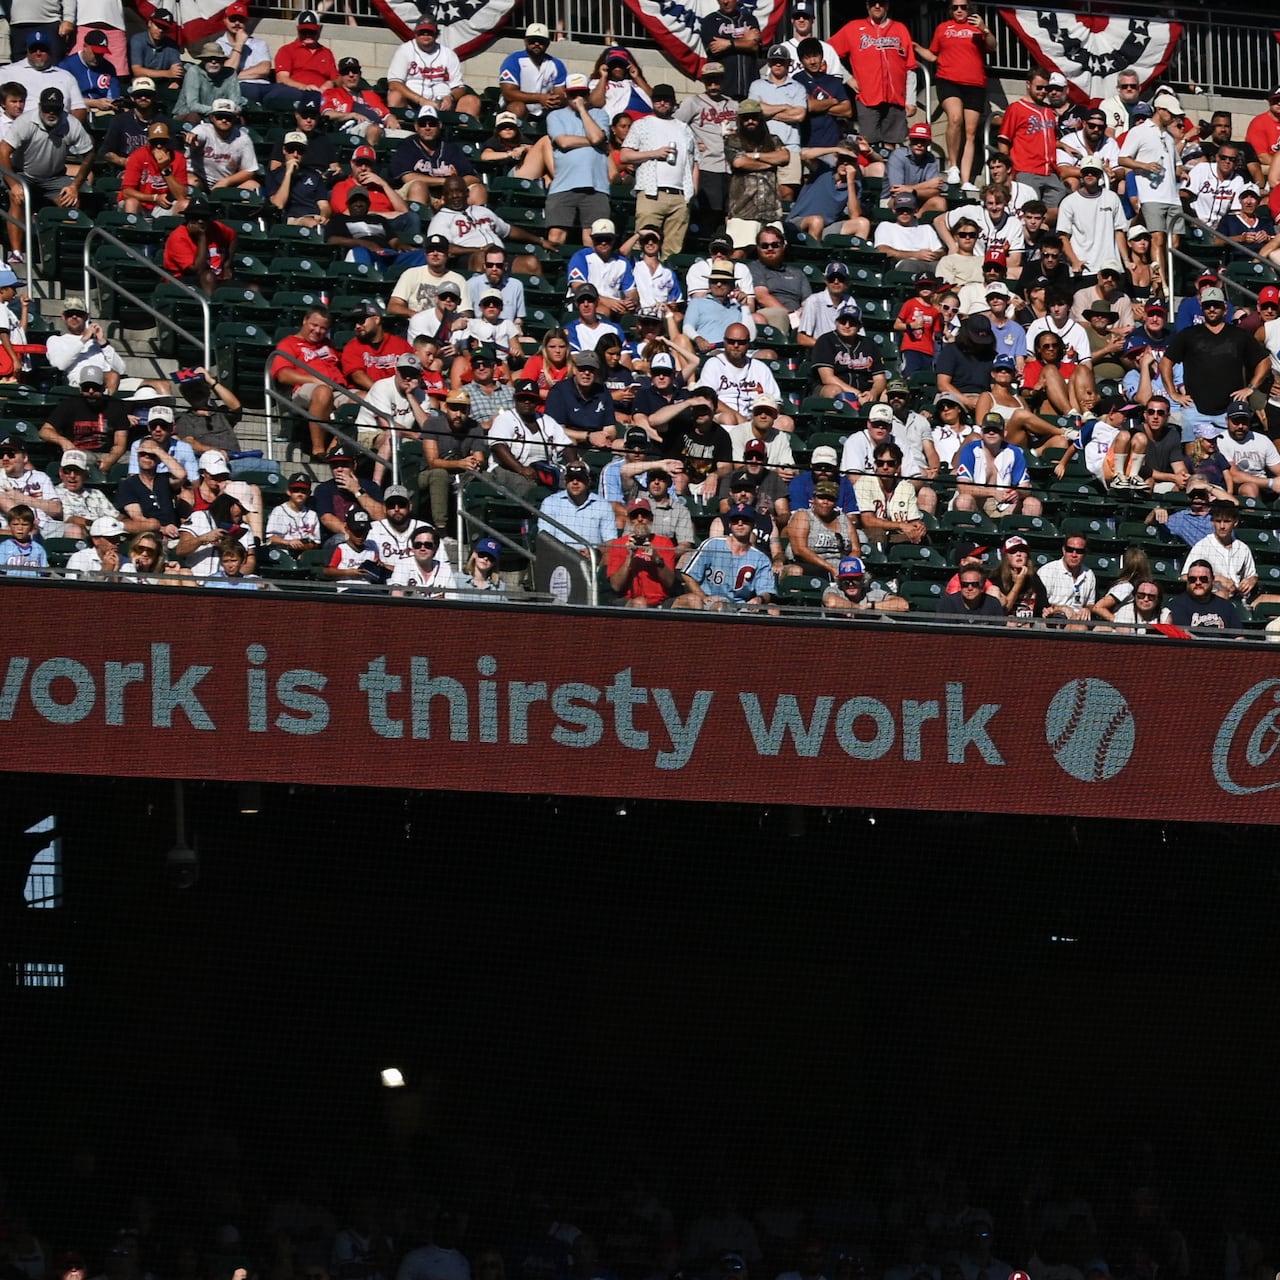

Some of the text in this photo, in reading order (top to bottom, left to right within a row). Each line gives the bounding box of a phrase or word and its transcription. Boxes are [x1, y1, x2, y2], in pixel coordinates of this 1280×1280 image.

[860, 34, 902, 50] Braves
[1200, 181, 1232, 197] Braves
[719, 375, 758, 393] Braves
[735, 566, 755, 589] P
[246, 644, 330, 735] is
[358, 655, 713, 770] thirsty
[739, 681, 1006, 767] work
